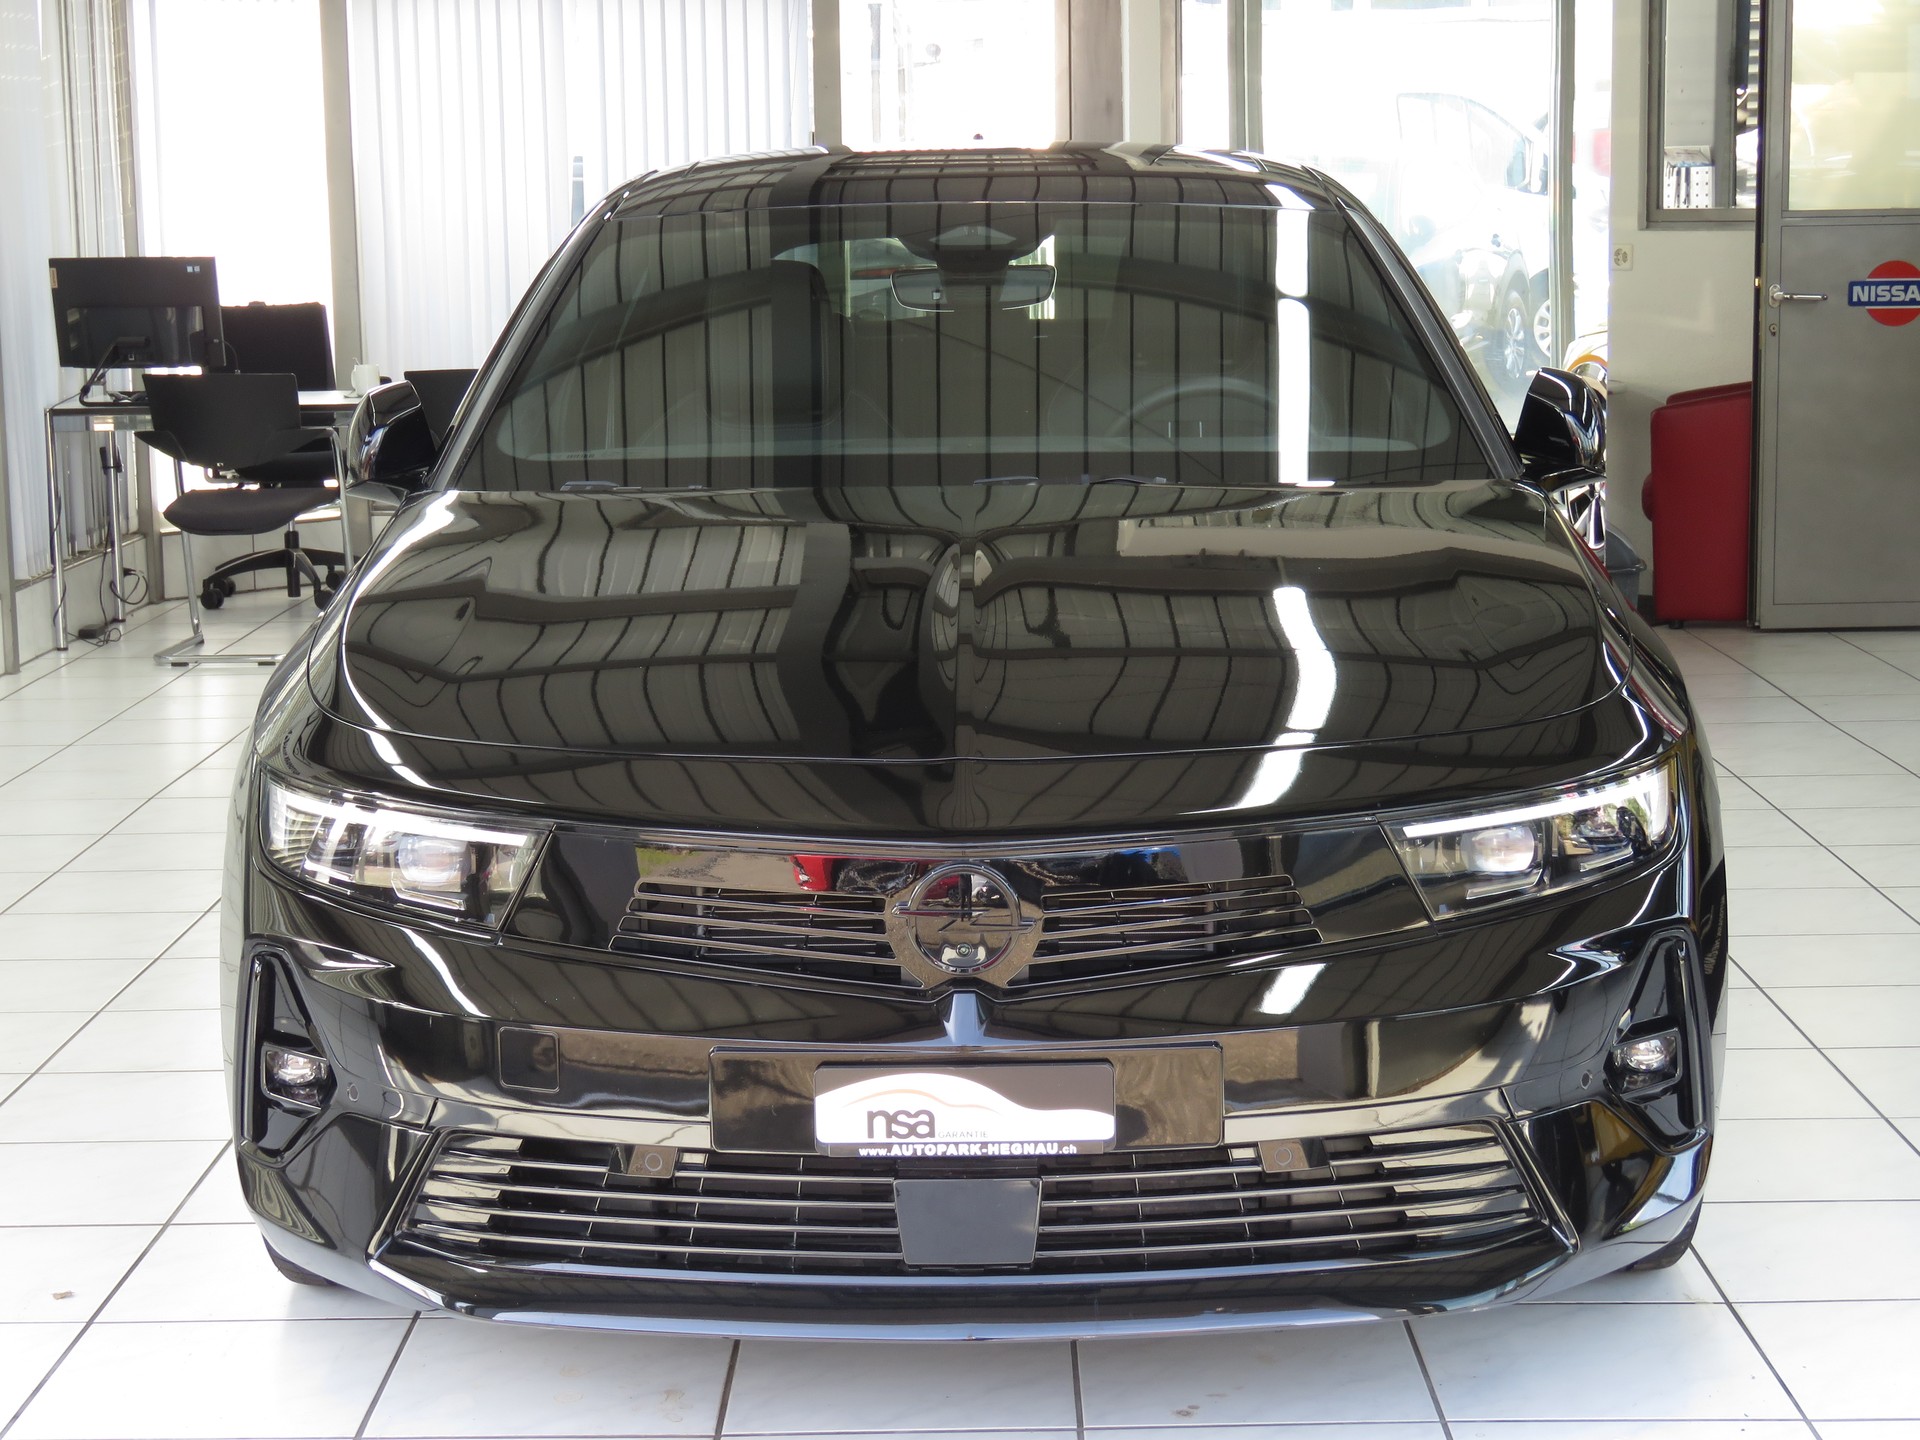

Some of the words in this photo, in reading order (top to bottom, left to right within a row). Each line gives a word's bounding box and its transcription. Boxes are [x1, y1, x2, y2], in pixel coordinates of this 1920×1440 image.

[867, 1109, 936, 1139] nsa
[937, 1130, 989, 1139] GARANTIE
[858, 1142, 1078, 1157] www.AUTOPARK-HEGNAU.ch
